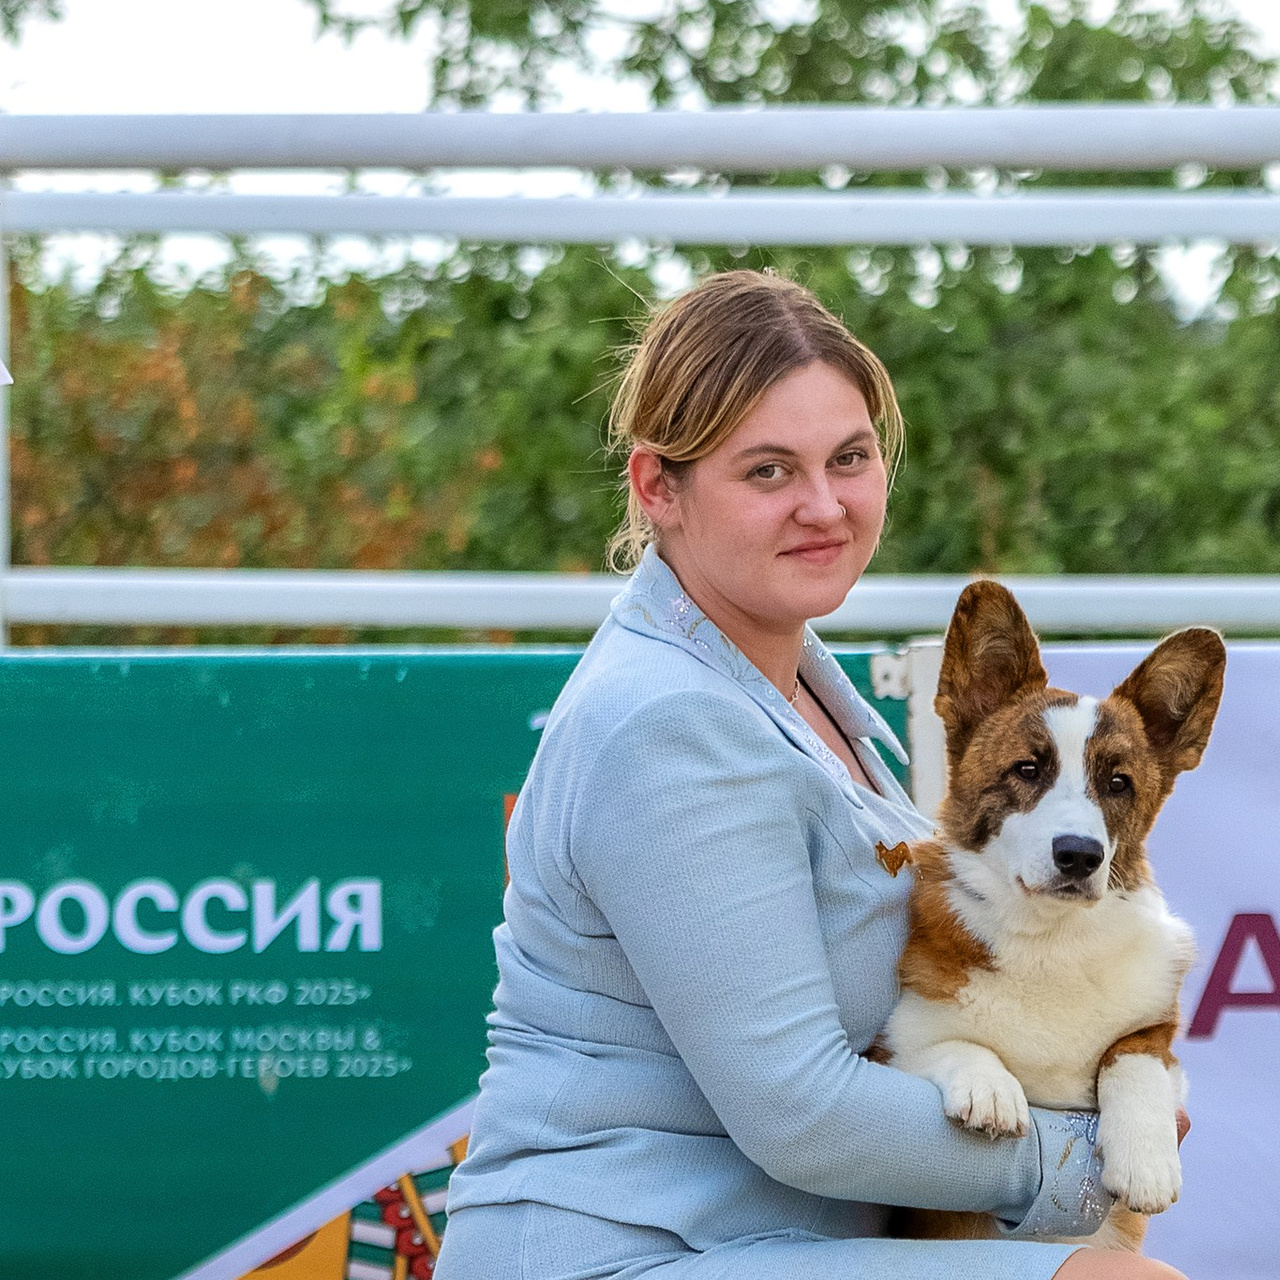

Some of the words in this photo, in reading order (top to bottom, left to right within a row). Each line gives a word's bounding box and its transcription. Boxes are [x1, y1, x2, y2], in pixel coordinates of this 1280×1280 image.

[0, 878, 383, 955] РОССИЯ
[128, 980, 223, 1006] КУБОК
[229, 979, 289, 1005] РКФ
[129, 1026, 223, 1052] КУБОК
[231, 1025, 355, 1052] МОСКВЫ
[0, 1053, 78, 1079] УБОК
